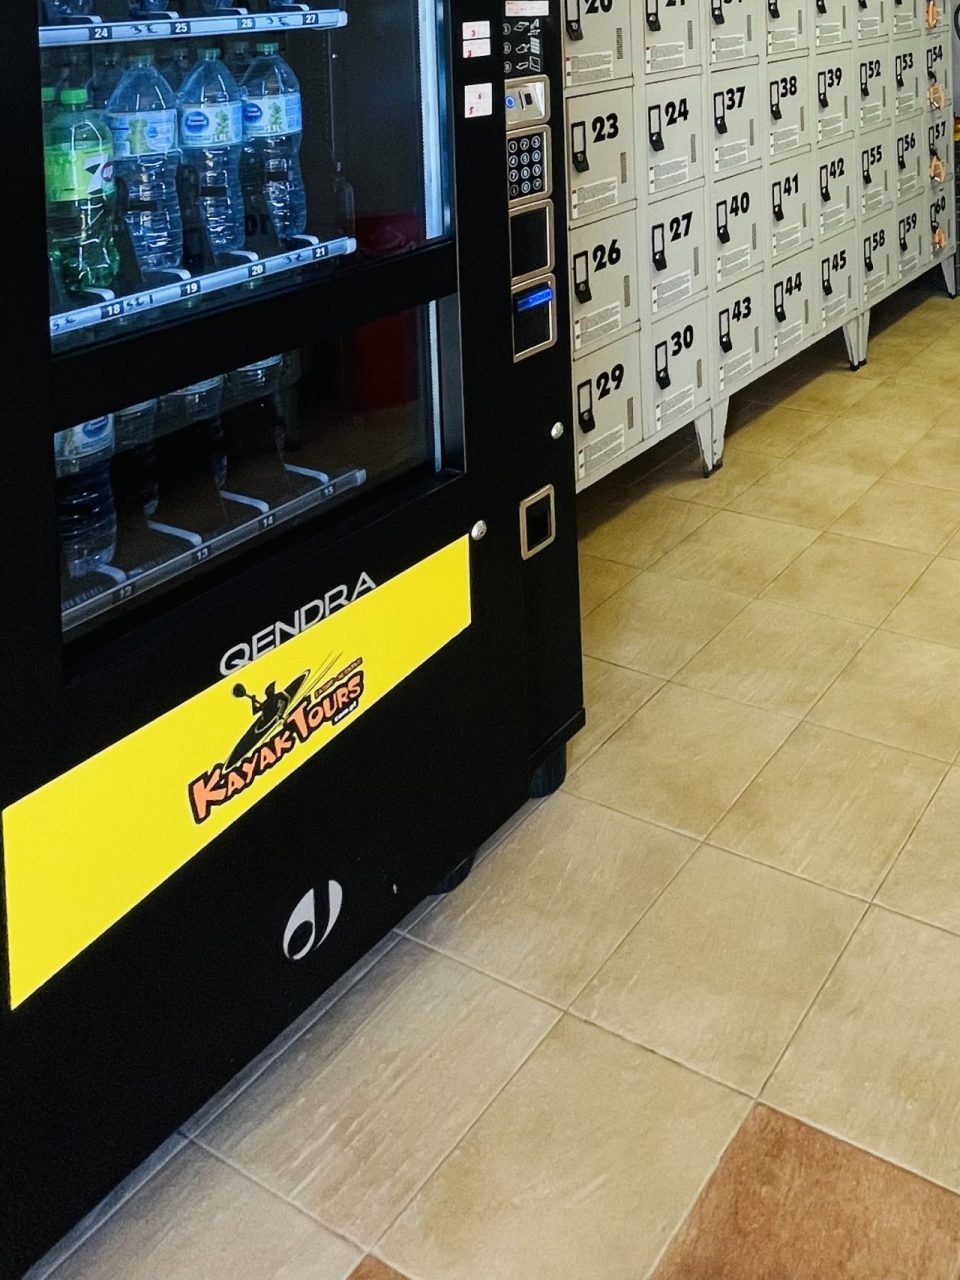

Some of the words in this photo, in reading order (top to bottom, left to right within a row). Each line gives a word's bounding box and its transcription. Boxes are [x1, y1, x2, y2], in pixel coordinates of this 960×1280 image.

[175, 22, 188, 33] 25
[305, 13, 316, 24] 27
[94, 28, 108, 39] 24
[903, 53, 913, 70] 53
[932, 46, 942, 63] 54
[828, 68, 842, 87] 39
[869, 60, 880, 78] 52
[781, 76, 797, 97] 38
[726, 86, 745, 110] 37
[665, 98, 688, 126] 24
[592, 113, 618, 143] 23
[935, 121, 945, 139] 57
[904, 133, 915, 152] 56
[870, 145, 882, 165] 55
[830, 158, 844, 178] 42
[784, 174, 798, 196] 41
[730, 192, 749, 216] 40
[934, 196, 945, 214] 60
[670, 212, 692, 242] 27
[905, 213, 917, 232] 59
[873, 229, 885, 251] 58
[315, 247, 326, 258] 21
[593, 240, 620, 272] 26
[832, 250, 846, 271] 45
[251, 264, 263, 276] 20
[185, 282, 198, 294] 19
[785, 272, 802, 295] 44
[107, 304, 121, 316] 18
[732, 297, 751, 322] 43
[671, 325, 693, 356] 30
[596, 364, 624, 400] 29
[220, 571, 377, 677] QENDRA
